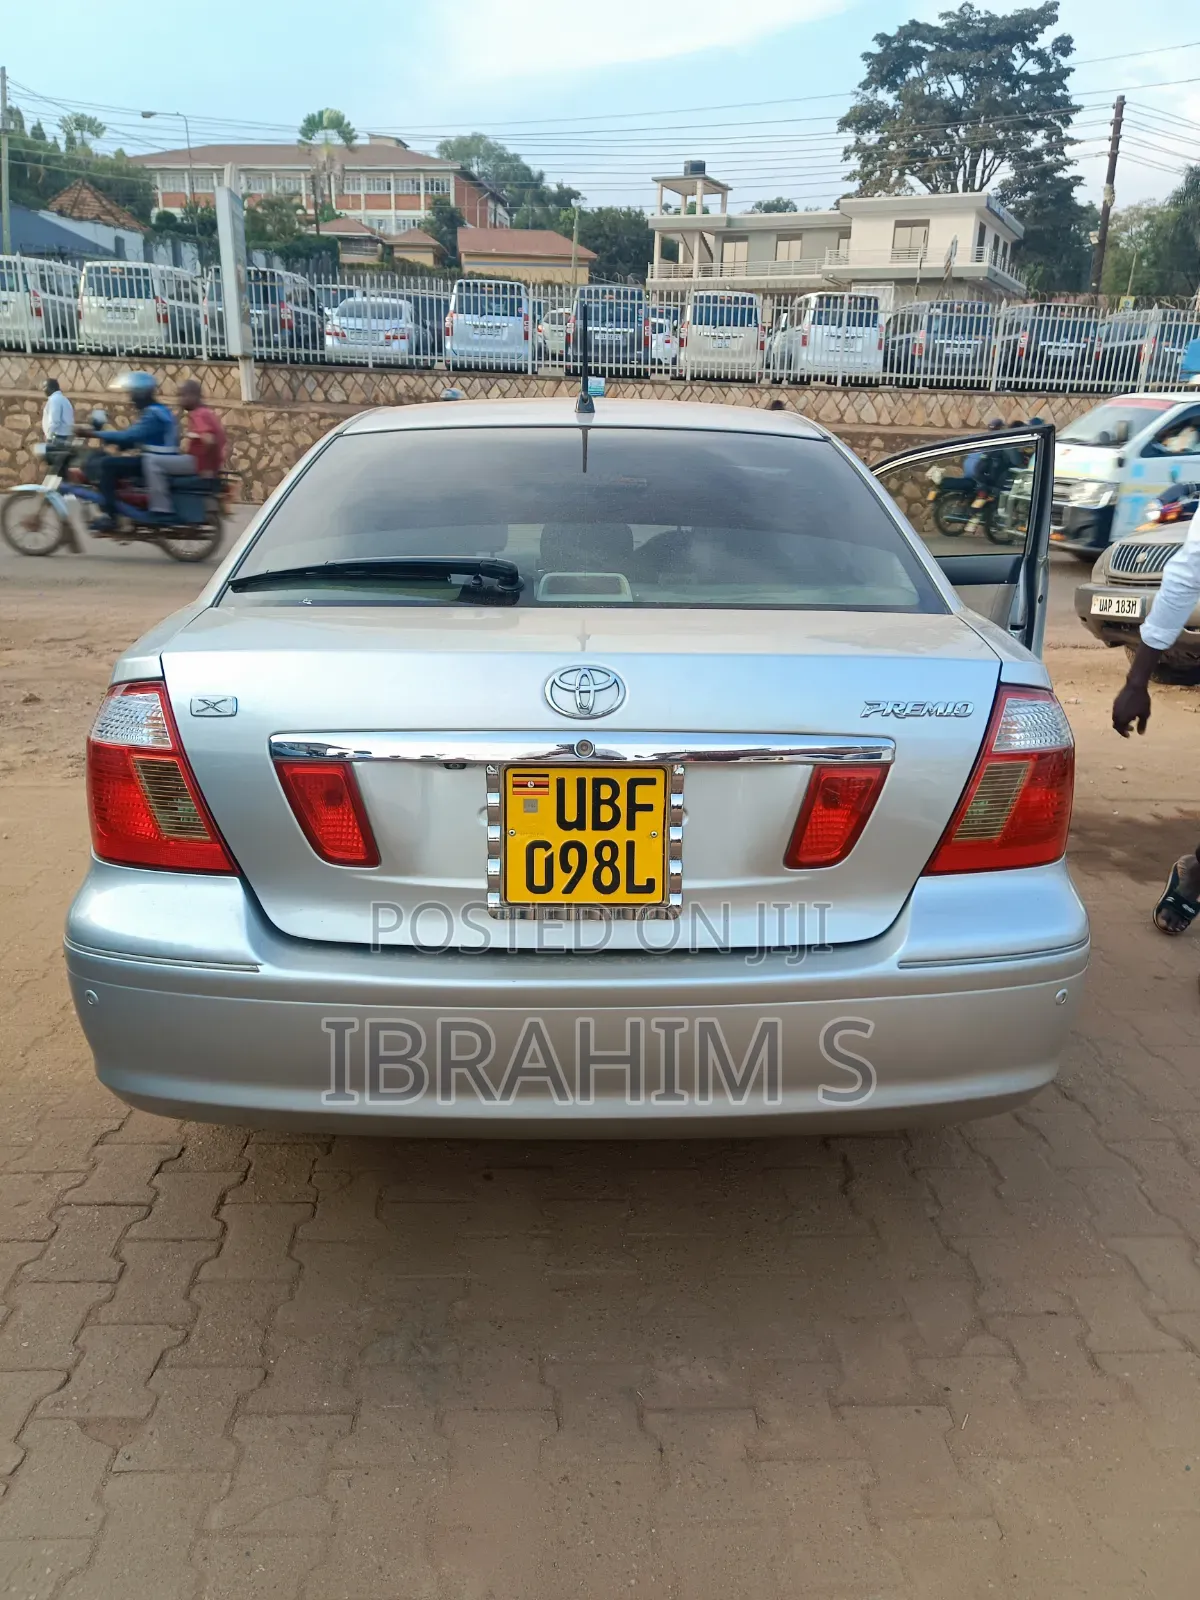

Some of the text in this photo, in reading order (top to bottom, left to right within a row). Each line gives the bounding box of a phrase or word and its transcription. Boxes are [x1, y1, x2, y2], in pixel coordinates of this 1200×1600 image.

[1099, 599, 1113, 612] UAP
[860, 700, 975, 719] PREMIO
[556, 777, 657, 831] UBF
[525, 840, 656, 894] 098L
